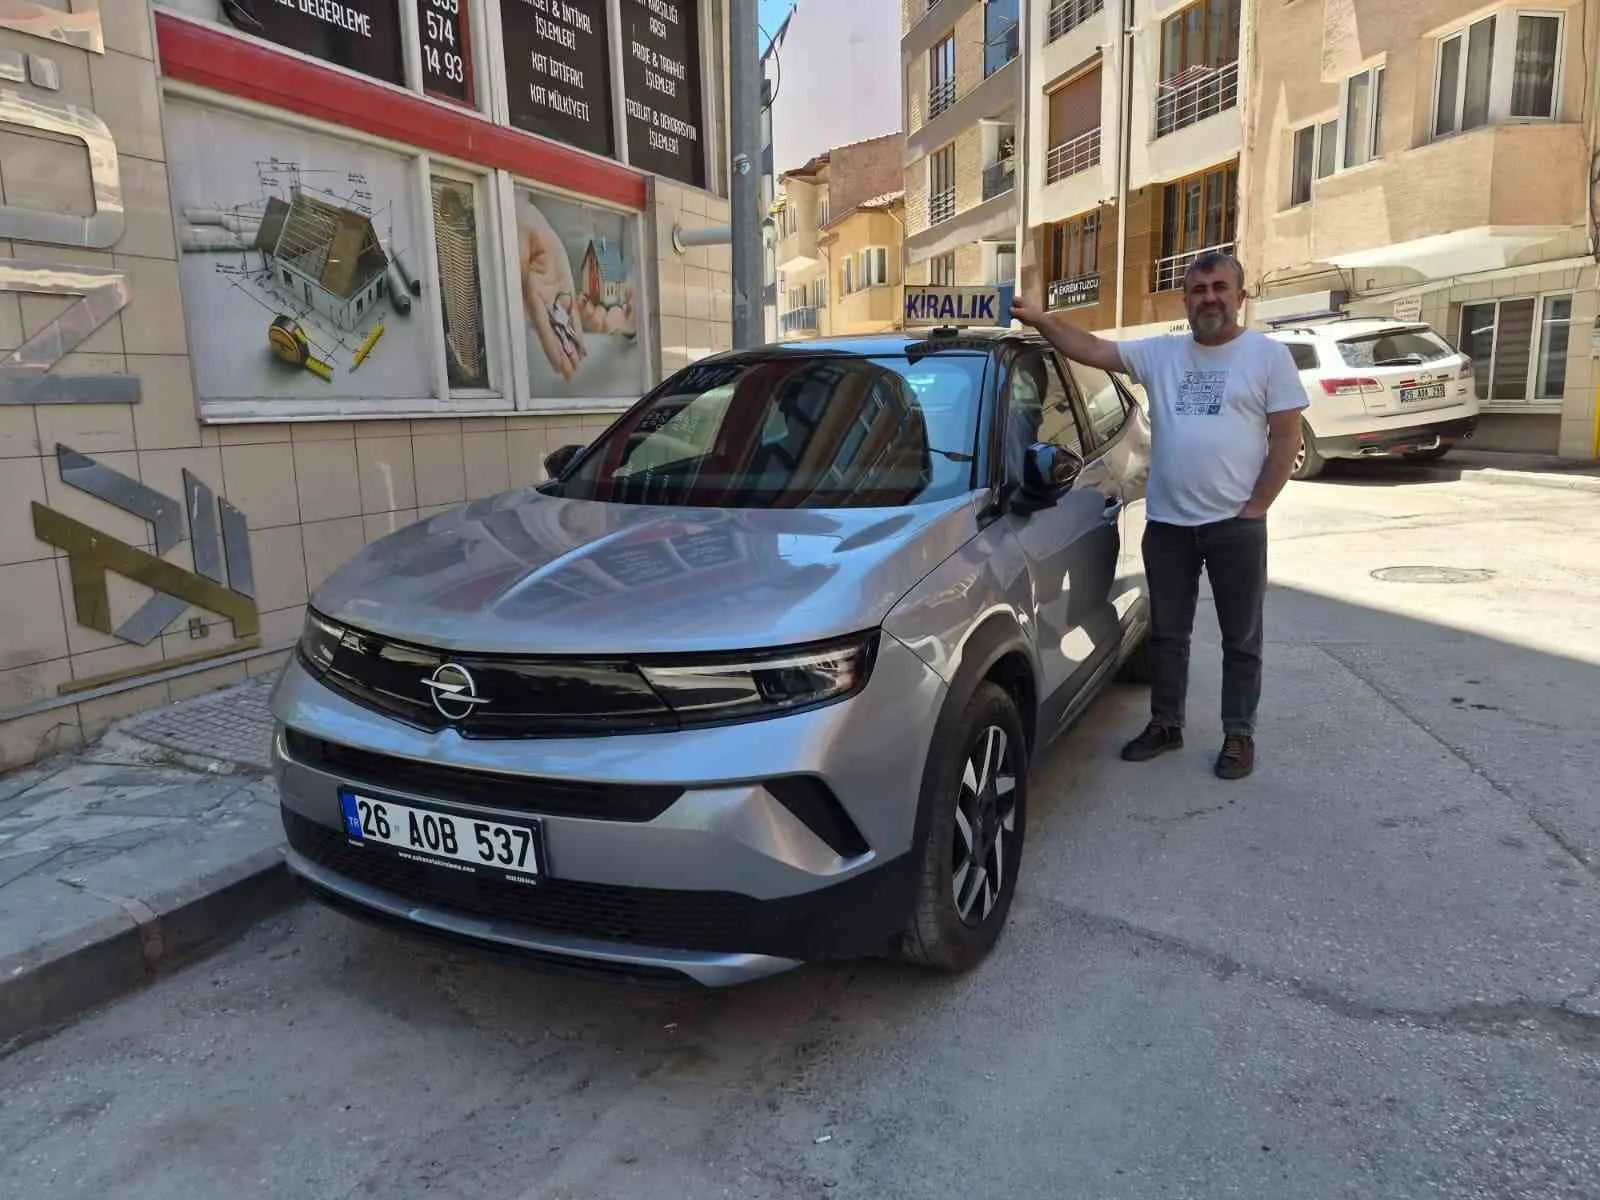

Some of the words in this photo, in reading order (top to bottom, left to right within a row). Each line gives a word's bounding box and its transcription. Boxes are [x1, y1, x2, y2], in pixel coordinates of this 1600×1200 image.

[426, 10, 455, 46] 574
[535, 12, 577, 50] İŞLEMLERİ
[424, 45, 441, 76] 14
[445, 52, 464, 83] 93
[531, 50, 548, 74] KAT
[530, 83, 546, 107] KAT
[548, 89, 590, 122] MÜLKİYETİ
[906, 289, 996, 319] KİRALIK
[358, 800, 391, 839] 26
[408, 811, 459, 854] AOB
[474, 822, 531, 868] 537
